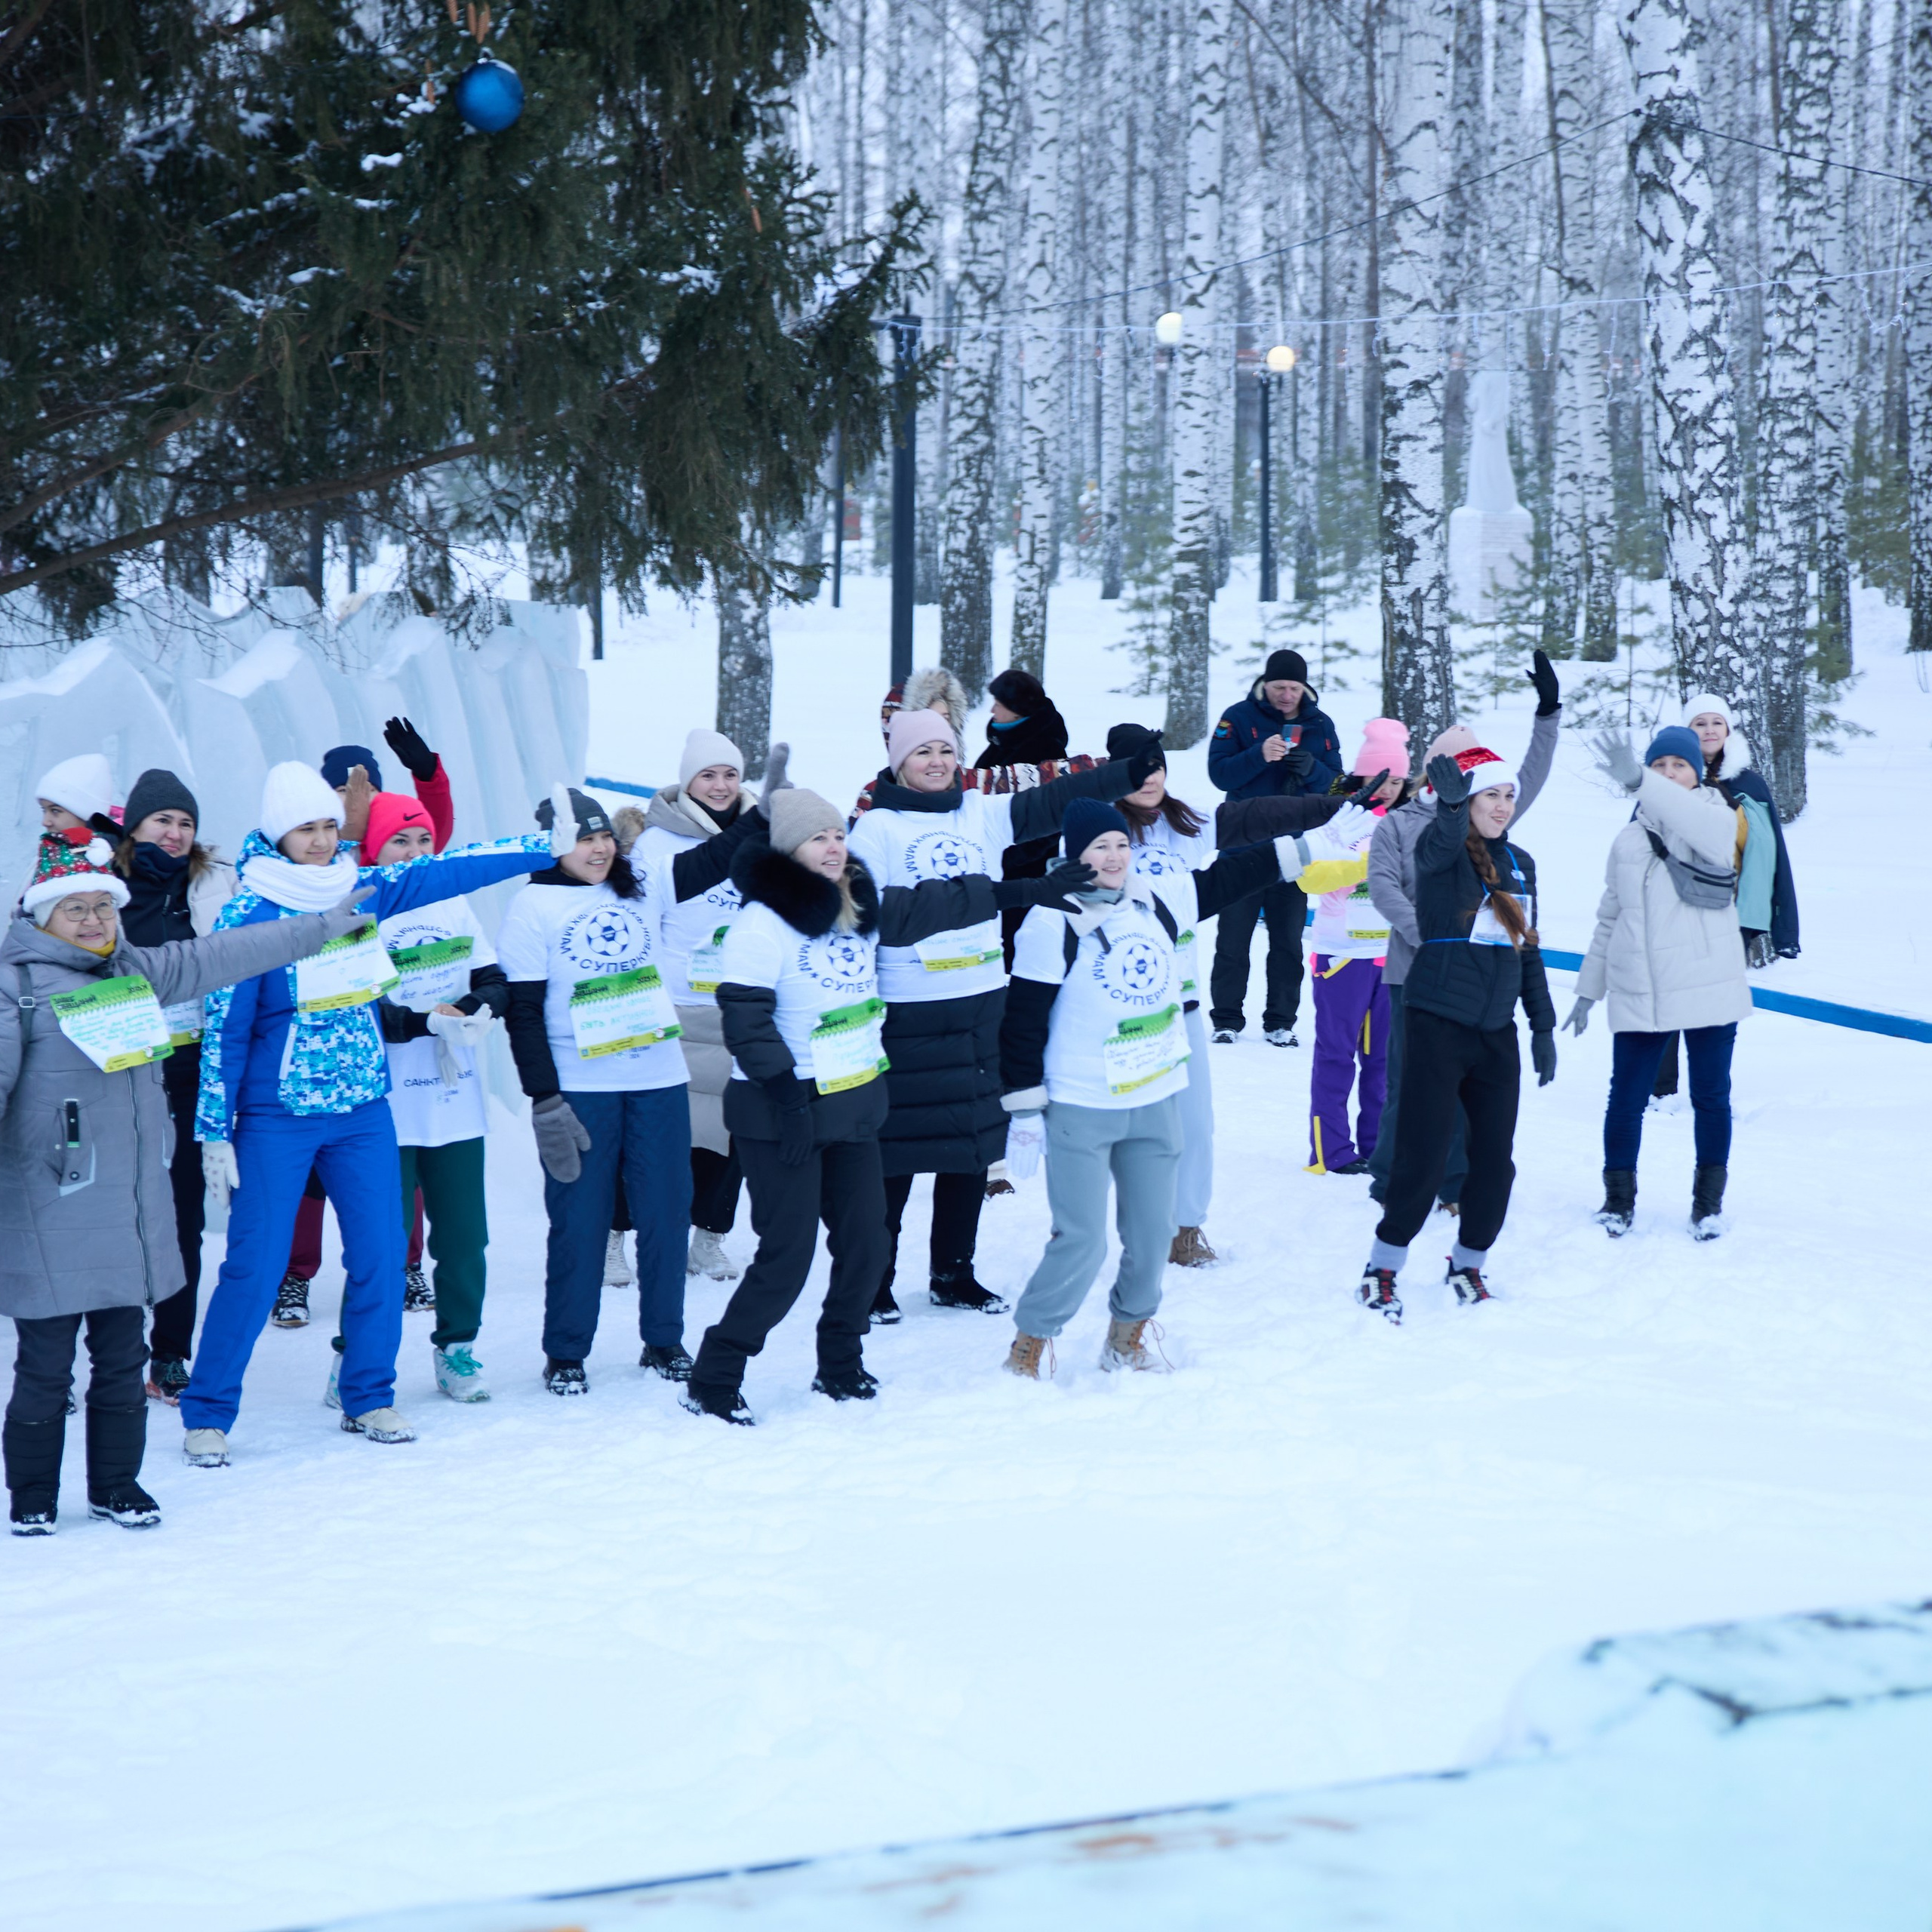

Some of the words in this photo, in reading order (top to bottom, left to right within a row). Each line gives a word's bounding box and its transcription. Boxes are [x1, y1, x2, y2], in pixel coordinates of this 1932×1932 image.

[904, 844, 918, 872] МАМ
[560, 926, 575, 955] МАМ
[797, 943, 813, 972] МАМ
